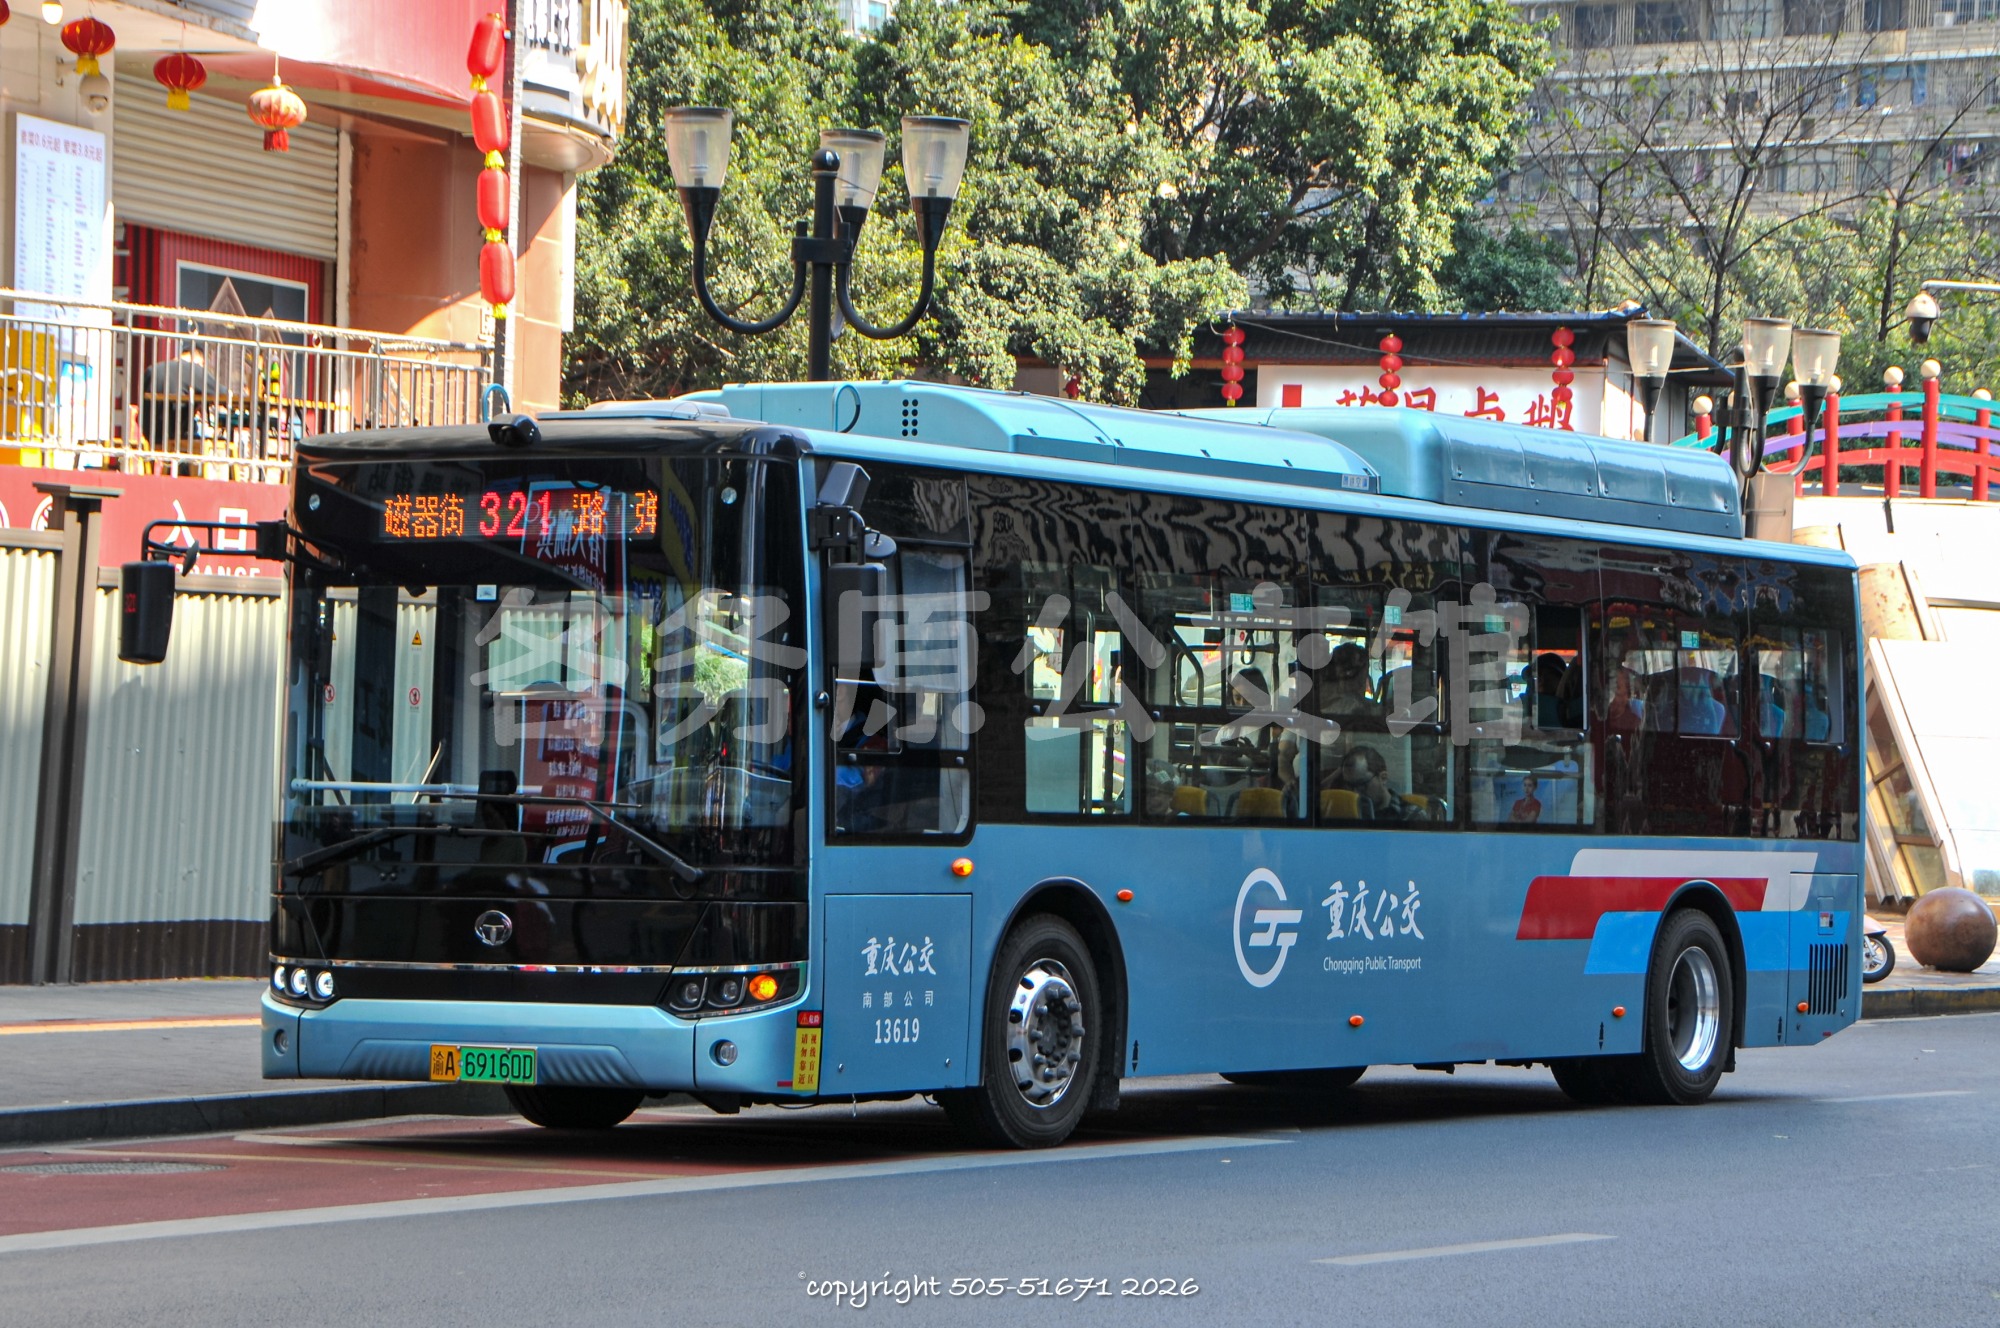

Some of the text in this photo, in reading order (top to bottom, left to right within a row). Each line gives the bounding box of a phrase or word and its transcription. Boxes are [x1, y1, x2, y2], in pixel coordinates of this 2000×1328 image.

[164, 499, 249, 558] 入口
[384, 493, 464, 538] 磁器街
[479, 491, 551, 537] 321
[572, 490, 607, 535] 路
[1321, 880, 1425, 941] 重庆公交
[861, 936, 937, 976] 重庆公交
[1323, 955, 1422, 974] Chongqing Public Transport
[862, 990, 934, 1009] 南部公司
[874, 1017, 921, 1044] 13619
[464, 1052, 533, 1080] 69160D
